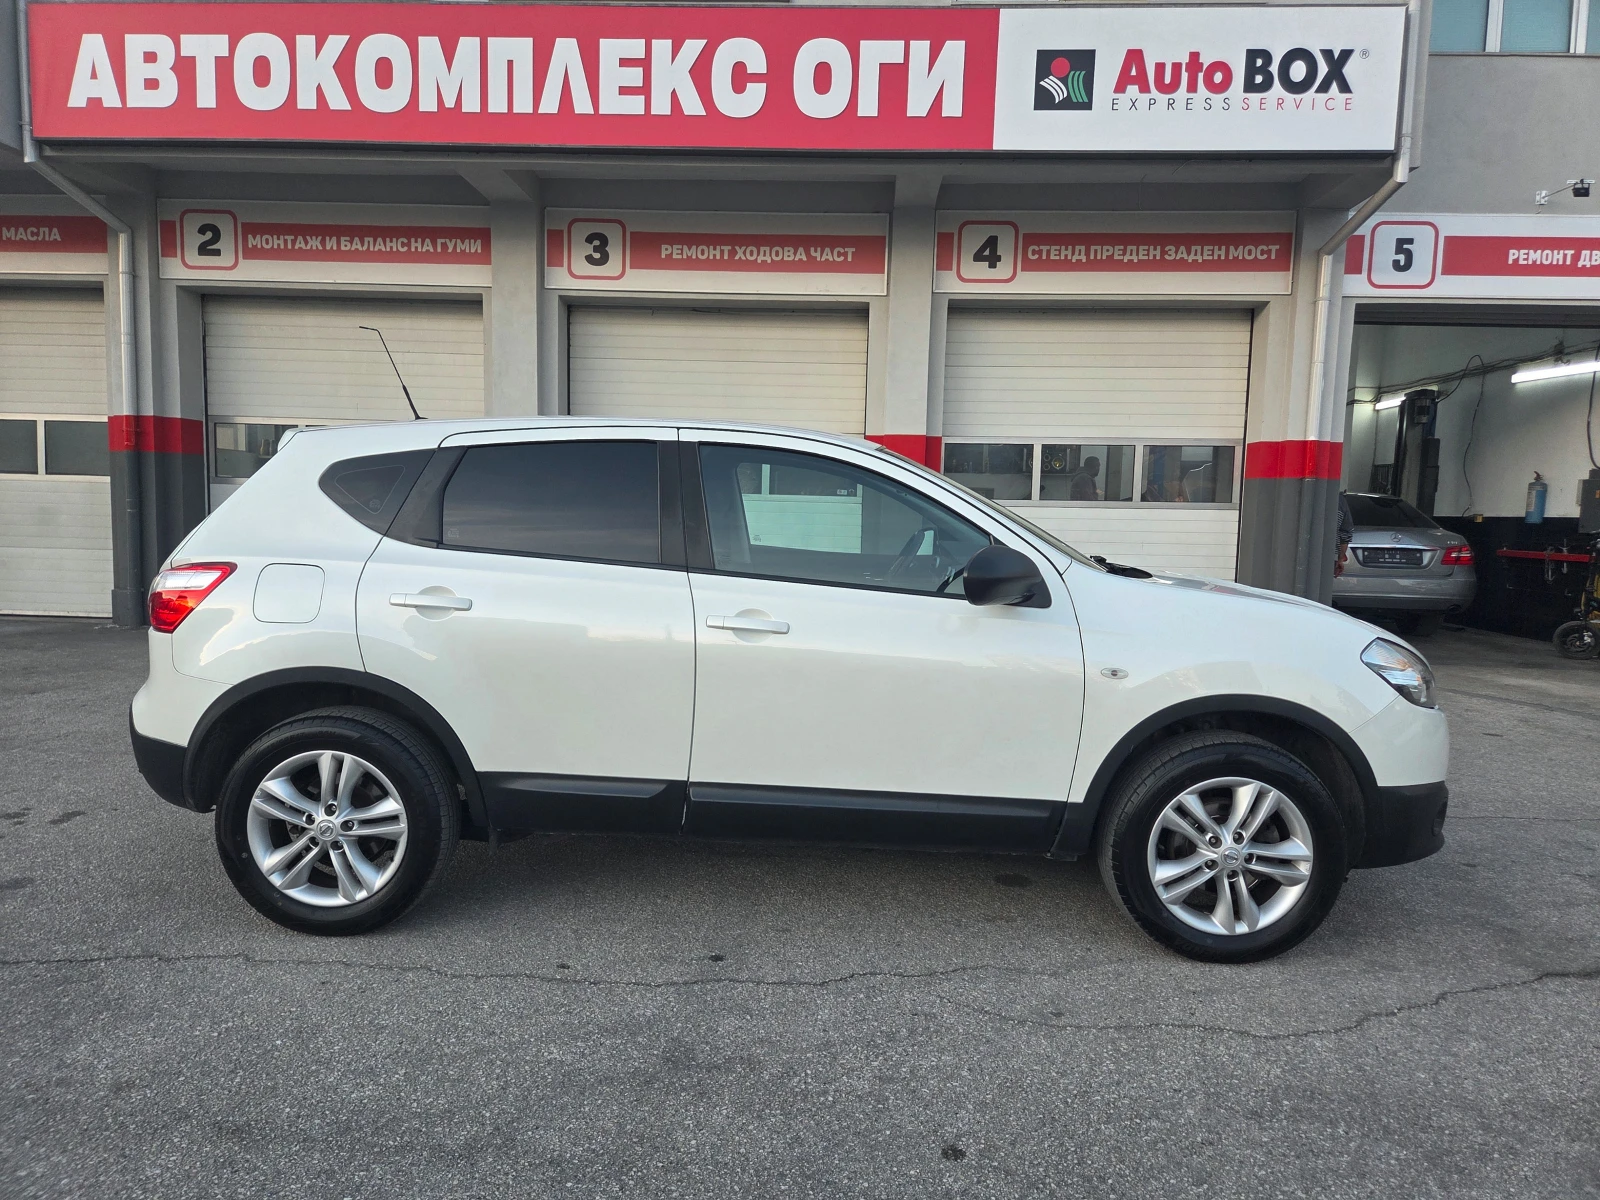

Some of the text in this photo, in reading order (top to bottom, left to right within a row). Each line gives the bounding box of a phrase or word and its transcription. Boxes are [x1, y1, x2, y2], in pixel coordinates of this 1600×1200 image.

[67, 32, 966, 119] АВТОКОМПЛЕКС ОГИ
[1112, 48, 1233, 95] Auto
[1242, 47, 1355, 95] BOX
[1, 226, 62, 242] МАСЛА
[196, 222, 222, 257] 2
[247, 234, 482, 254] МОНТАЖ И БАЛАНС НА ГУМИ
[584, 232, 610, 267] 3
[660, 244, 856, 263] РЕМОНТ ХОДОВА ЧАСТ
[972, 235, 1002, 269] 4
[1027, 245, 1280, 262] СТЕНД ПРЕДЕН ЗАДЕН МОСТ
[1391, 237, 1415, 273] 5
[1507, 249, 1575, 265] РЕМОНТ
